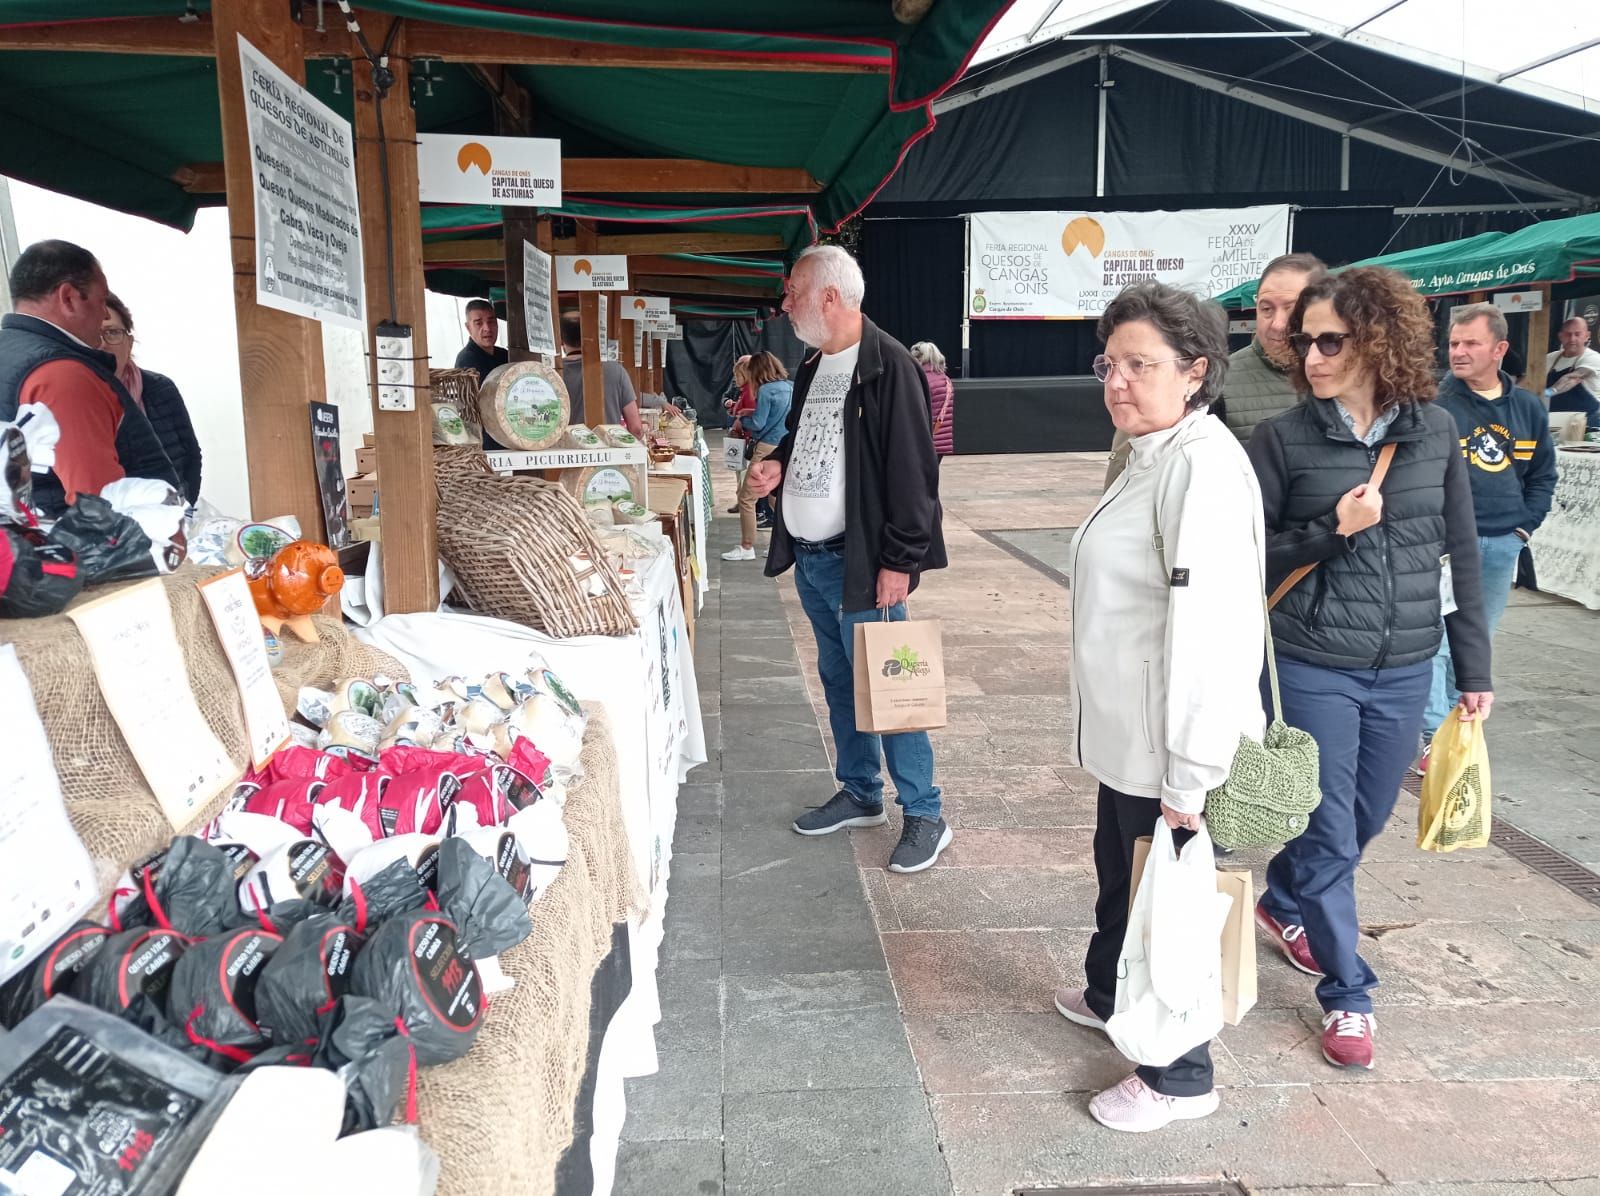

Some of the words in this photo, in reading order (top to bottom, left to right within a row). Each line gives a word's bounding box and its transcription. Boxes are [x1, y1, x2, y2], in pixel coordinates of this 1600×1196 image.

[284, 94, 332, 139] REGIONAL
[332, 128, 345, 148] DE
[250, 89, 292, 128] QUESOS
[294, 119, 307, 140] DE
[309, 130, 350, 168] ASTURIAS
[492, 177, 519, 188] CAPITAL
[520, 178, 532, 188] DEL
[533, 179, 554, 189] QUESO
[492, 188, 500, 198] DE
[502, 188, 534, 199] ASTURIAS
[259, 173, 287, 200] Queso:
[288, 188, 315, 215] Quesos
[315, 203, 351, 234] Madurados
[351, 226, 358, 238] de
[280, 208, 306, 235] Cabra,
[306, 221, 325, 242] Vaca
[325, 233, 330, 247] y
[330, 233, 348, 255] Oveja
[1228, 224, 1261, 235] XXXV
[986, 243, 1006, 251] FERIA
[1008, 243, 1048, 251] REGIONAL
[1208, 236, 1243, 248] FERIA
[1104, 250, 1129, 258] CANGAS
[1222, 248, 1256, 262] MIEL
[981, 254, 1031, 269] QUESOS
[1103, 259, 1137, 272] CAPITAL
[1139, 258, 1155, 271] DEL
[1156, 258, 1184, 271] QUESO
[989, 268, 1048, 281] CANGAS
[1210, 261, 1262, 278] ORIENTE
[1456, 269, 1494, 288] Cangas
[1496, 263, 1509, 279] de
[1103, 273, 1114, 286] DE
[526, 452, 612, 466] PICURRIELLU
[415, 937, 430, 958] QUESO
[425, 922, 439, 940] VIEJO
[128, 951, 152, 974] QUESO
[150, 935, 171, 955] VIEJO
[226, 952, 249, 977] QUESO
